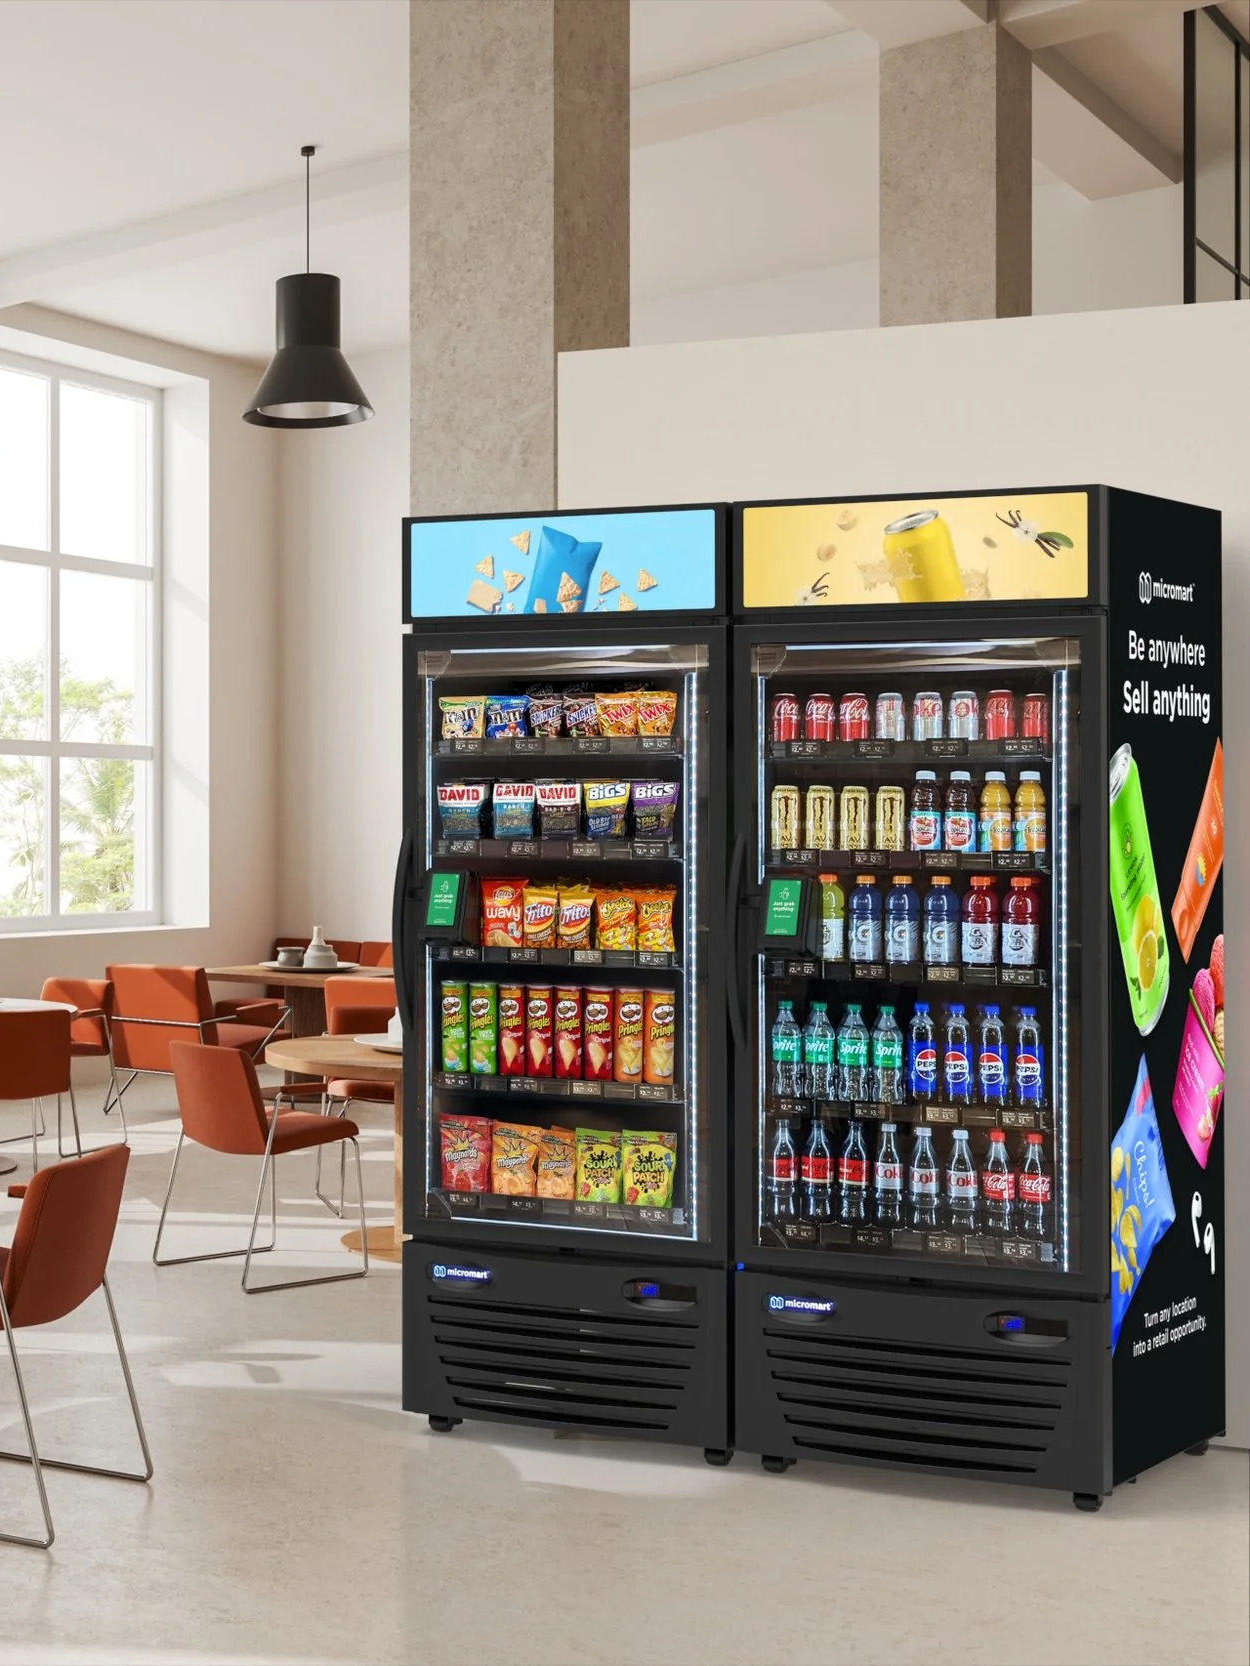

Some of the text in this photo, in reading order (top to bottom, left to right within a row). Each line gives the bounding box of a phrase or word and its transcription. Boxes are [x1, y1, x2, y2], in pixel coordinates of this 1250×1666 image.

[1129, 630, 1205, 669] Be anywhere
[1123, 680, 1210, 724] Sell anything
[439, 789, 480, 800] DAVID
[496, 786, 534, 796] DAVID
[540, 787, 576, 799] DAVID
[525, 902, 552, 924] Frito
[773, 1039, 796, 1051] prite
[806, 1040, 829, 1052] prite
[876, 1043, 902, 1057] Sprit
[633, 1172, 664, 1182] PATCH
[448, 1268, 488, 1279] micromart
[785, 1299, 830, 1311] micromart
[1144, 1296, 1196, 1328] Turn any location
[1133, 1340, 1146, 1357] into
[1147, 1339, 1151, 1351] a
[1153, 1328, 1169, 1349] retail
